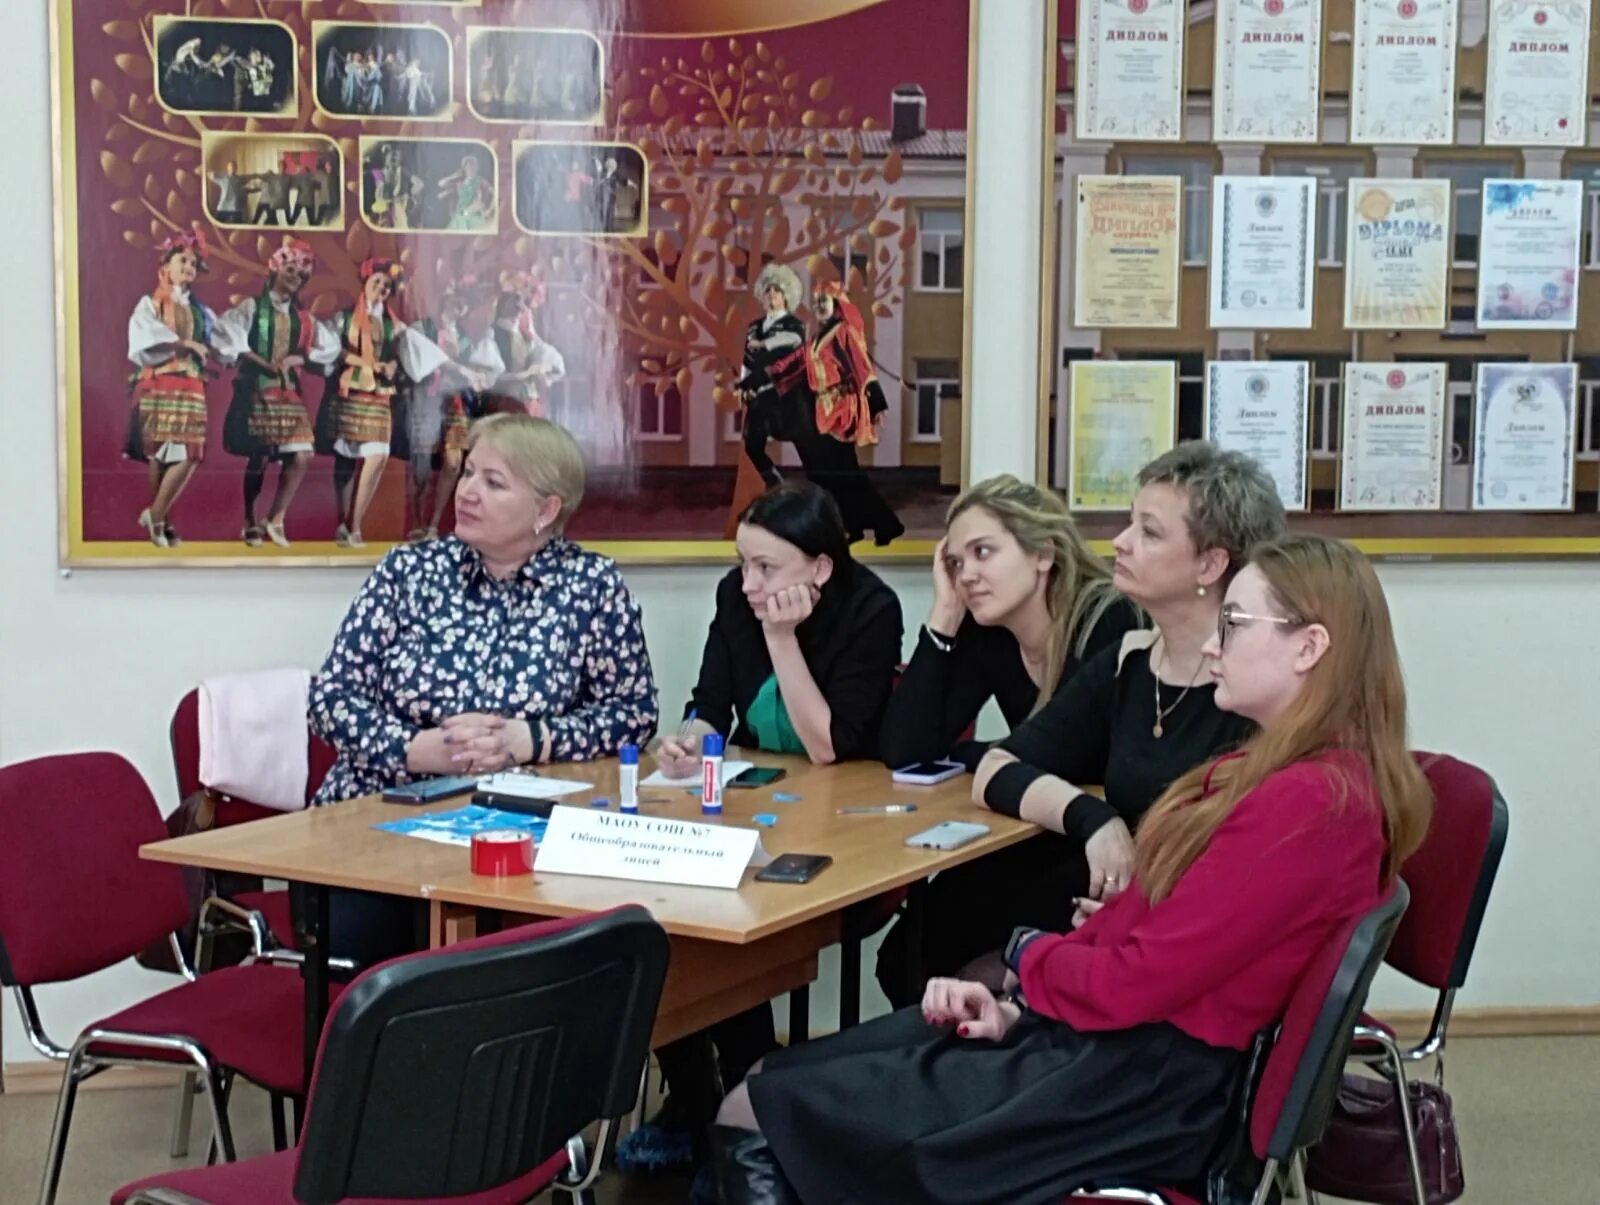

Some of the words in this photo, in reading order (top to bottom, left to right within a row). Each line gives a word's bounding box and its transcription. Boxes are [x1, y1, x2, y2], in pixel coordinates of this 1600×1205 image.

[1106, 30, 1168, 42] ДИПЛОМ
[1241, 32, 1304, 44] ДИПЛОМ
[1375, 35, 1437, 46] ДИПЛОМ
[1508, 42, 1569, 53] ДИПЛОМ
[1358, 220, 1443, 242] DIPLOMA
[1365, 405, 1425, 416] ДИПЛОМ
[597, 815, 640, 829] МАОУ
[646, 823, 685, 836] СОШ
[570, 831, 725, 859] Общеобразовательный
